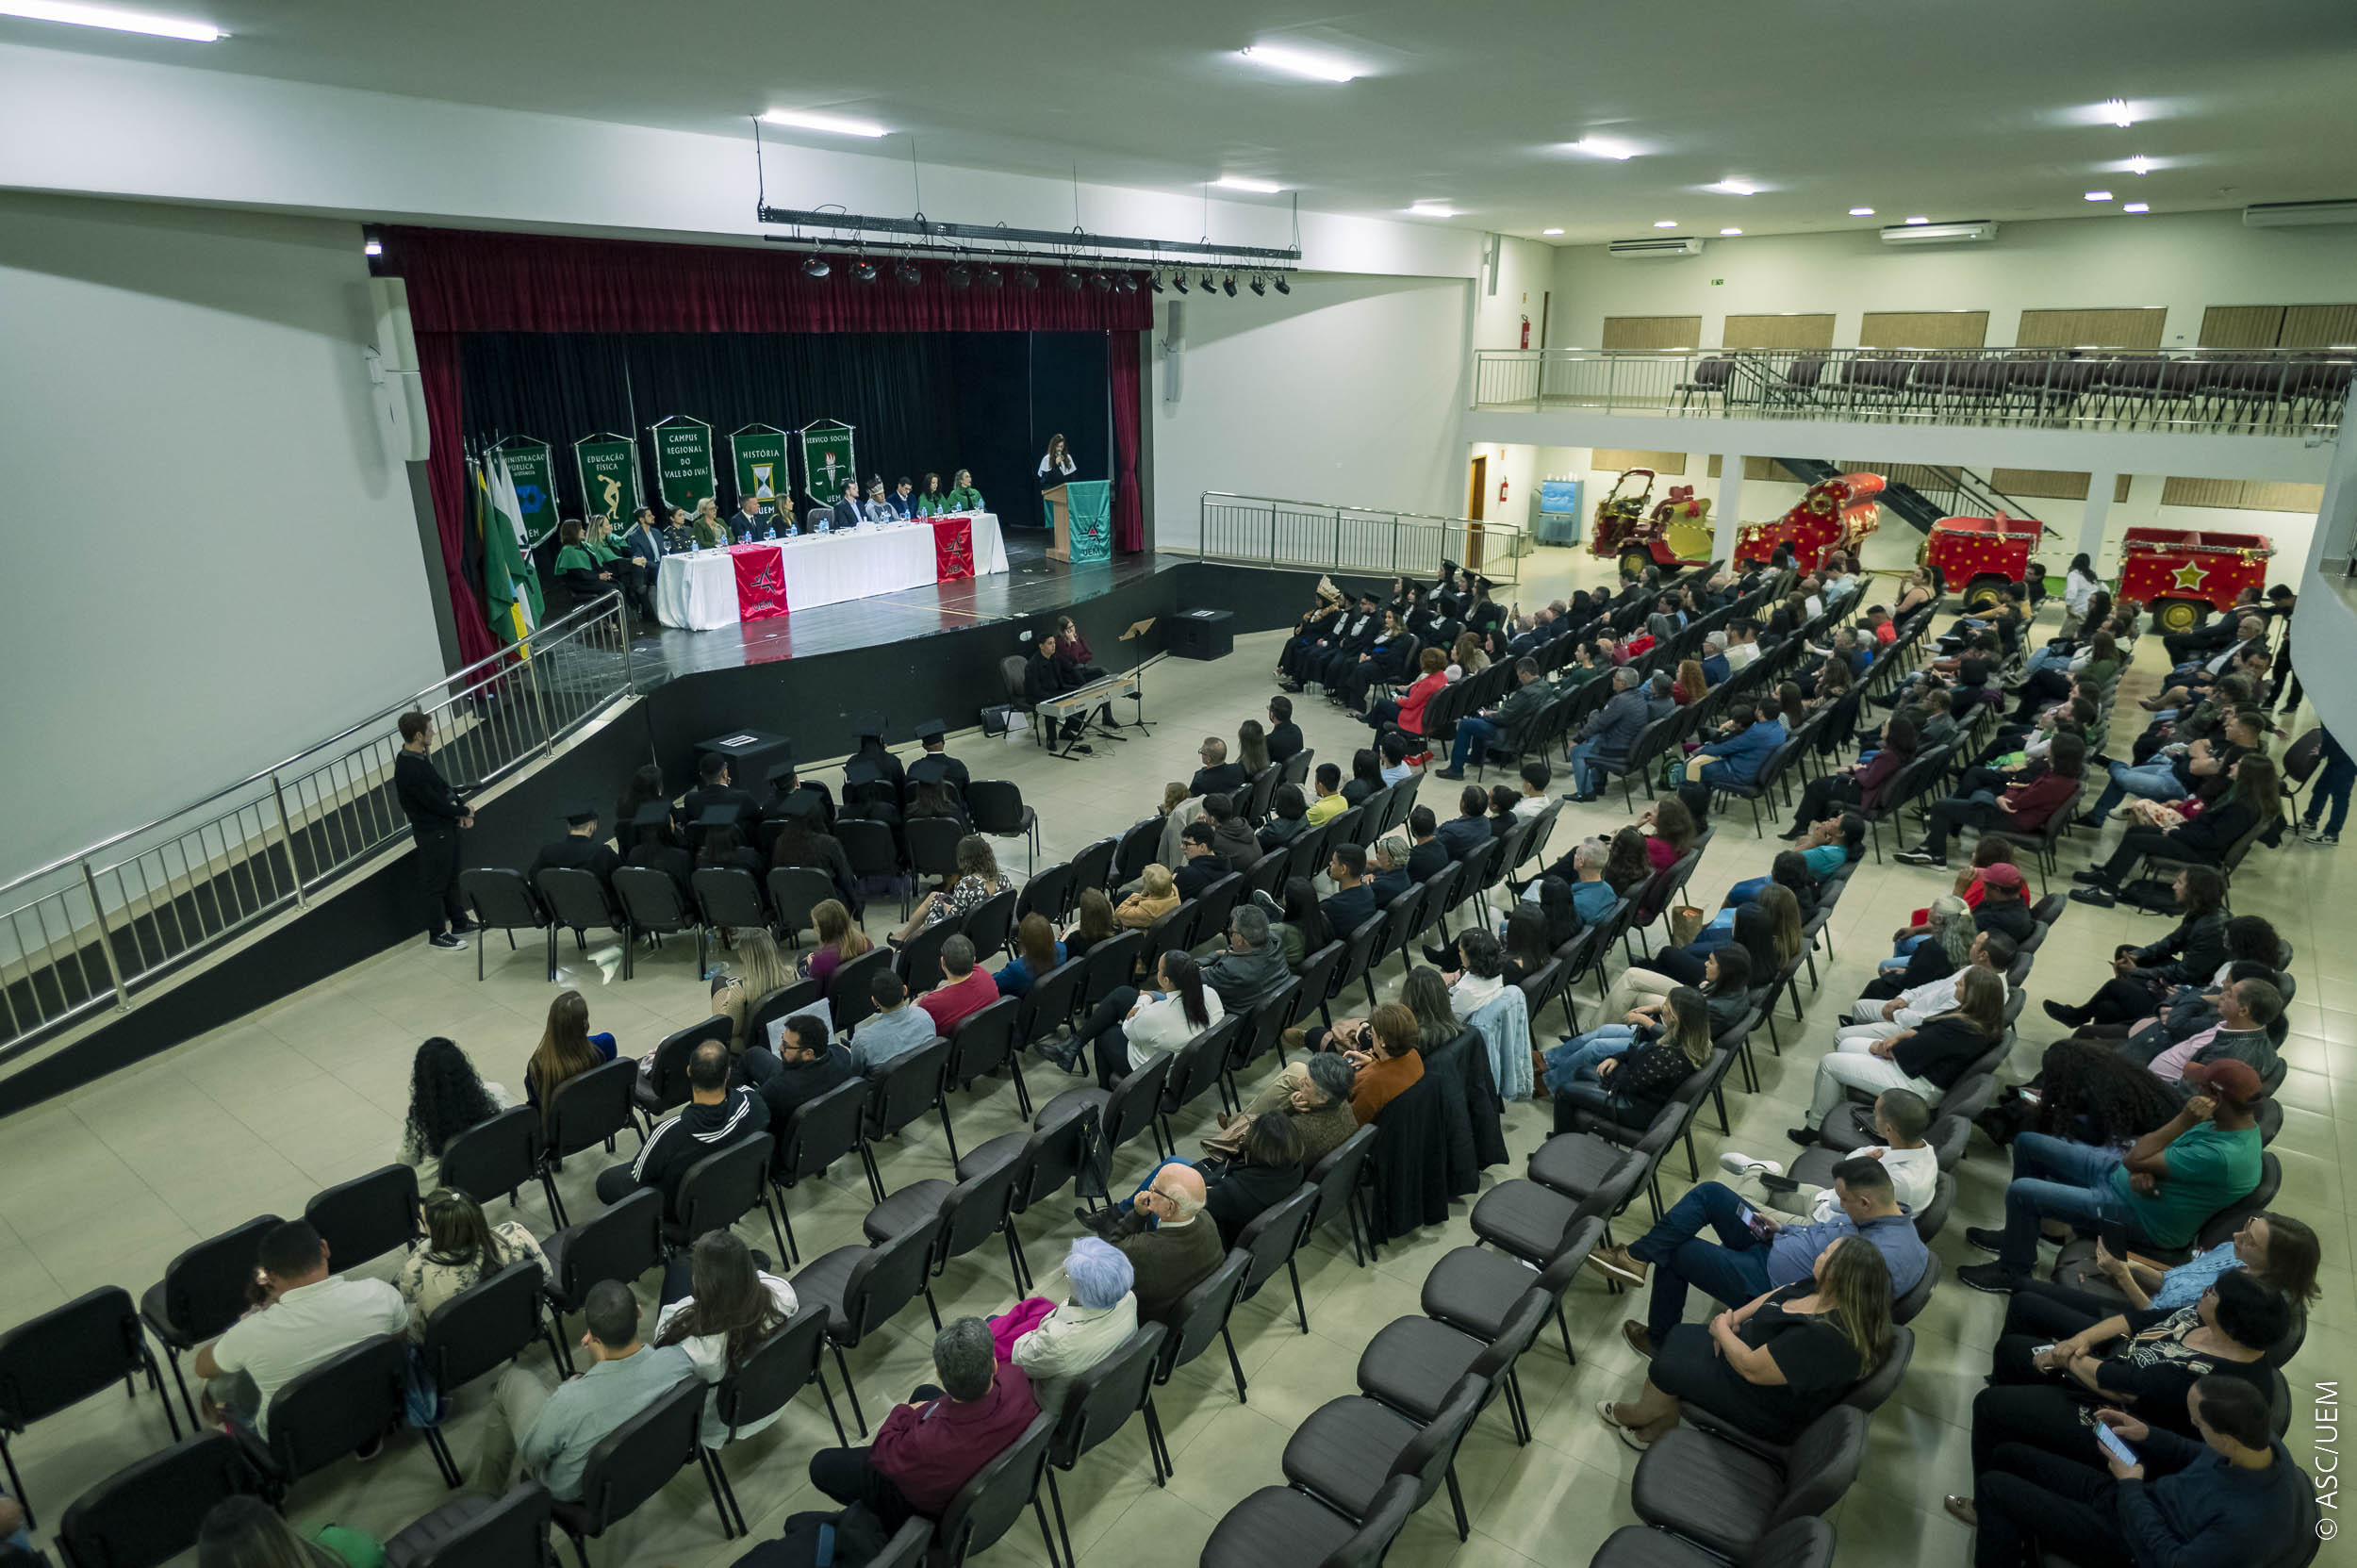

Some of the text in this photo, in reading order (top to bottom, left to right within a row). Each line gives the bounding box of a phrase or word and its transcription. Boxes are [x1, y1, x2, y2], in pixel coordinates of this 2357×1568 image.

[668, 434, 698, 443] CAMPUS
[830, 434, 849, 442] SOCIAL
[667, 445, 702, 454] REGIONAL
[742, 449, 780, 459] HISTÓRIA
[586, 453, 624, 464] EDUCAÇÃO
[596, 462, 618, 471] FÍSICA
[694, 466, 708, 476] IVAÍ
[758, 506, 774, 515] UEM
[528, 529, 540, 537] EM
[1082, 548, 1100, 556] UEM
[752, 599, 774, 611] UEM
